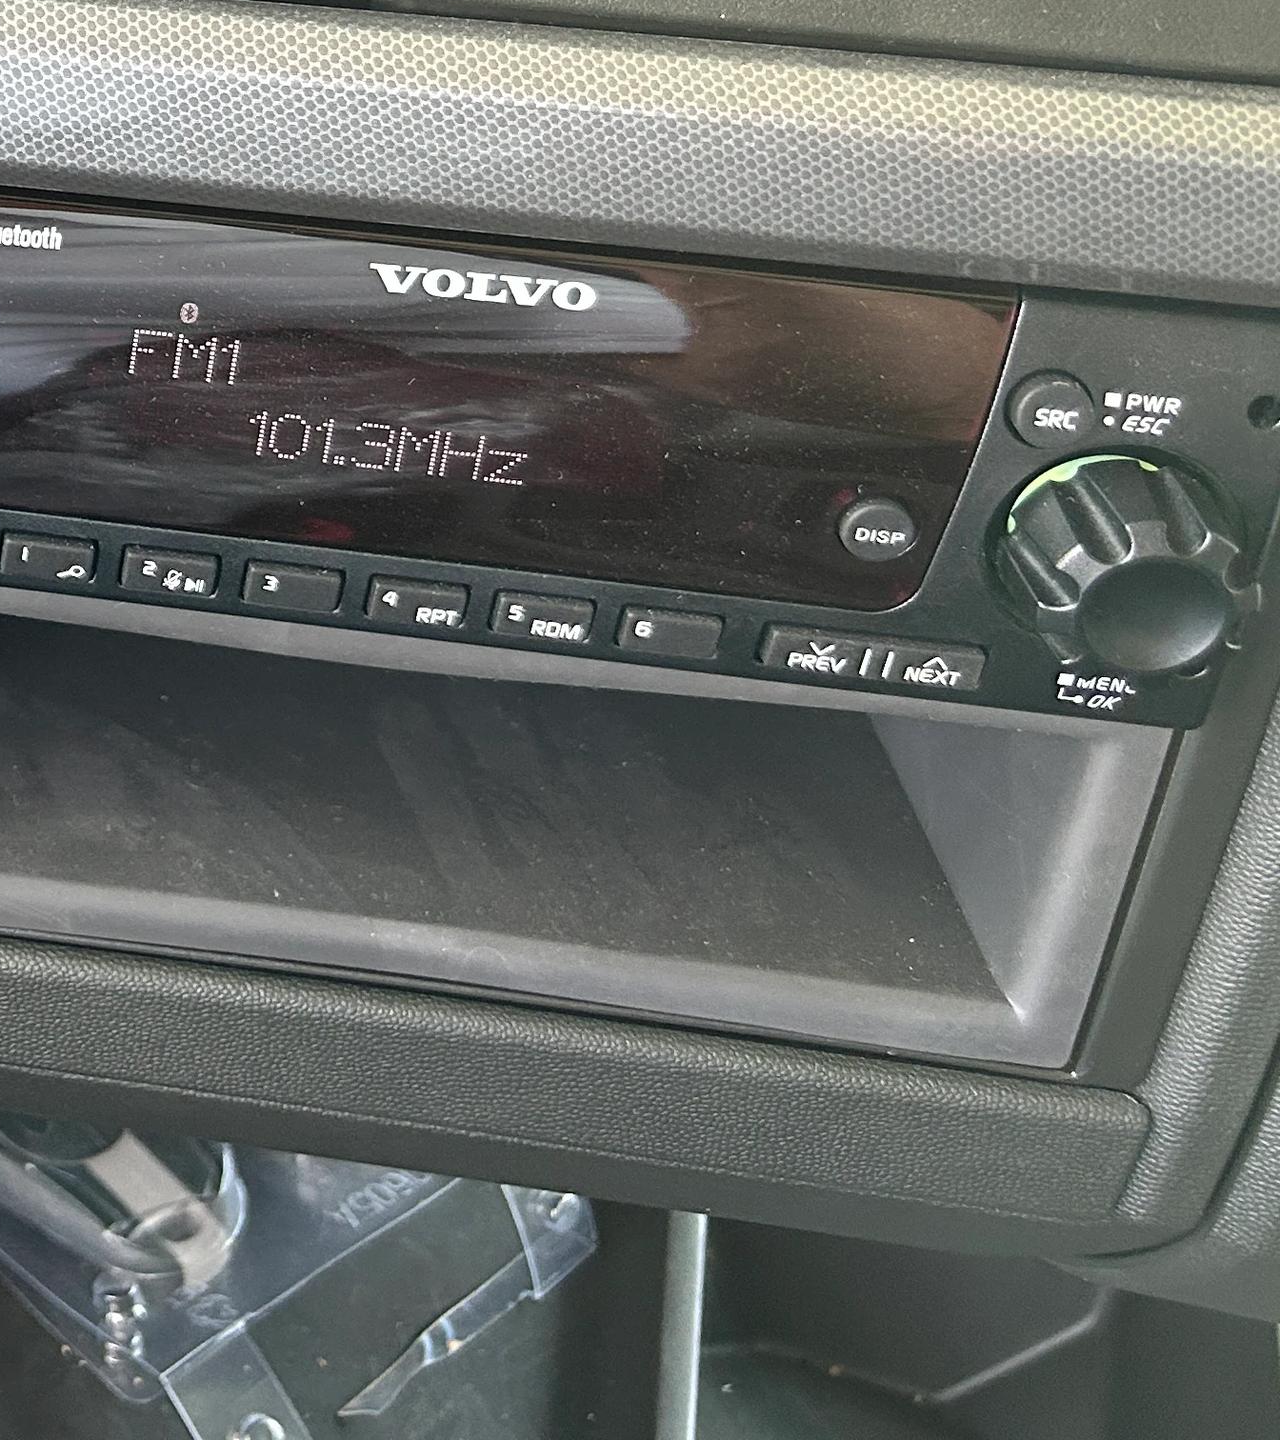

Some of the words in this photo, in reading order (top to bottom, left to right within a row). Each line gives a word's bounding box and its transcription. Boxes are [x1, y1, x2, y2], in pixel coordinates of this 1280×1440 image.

[369, 262, 600, 311] VOLVO
[128, 328, 241, 386] FM1
[1125, 393, 1183, 417] PWR
[1033, 407, 1080, 432] SRC
[1121, 415, 1172, 437] ESC
[248, 410, 528, 487] 101.3MHz
[854, 526, 906, 546] DISP
[142, 560, 158, 577] 2
[262, 574, 280, 592] 3
[381, 591, 399, 608] 4
[415, 606, 458, 627] RPT
[507, 604, 526, 622] 5
[530, 618, 581, 641] RDM
[634, 620, 652, 638] 6
[787, 652, 848, 674] PREV
[903, 666, 962, 687] NEXT
[1086, 694, 1122, 711] OK
